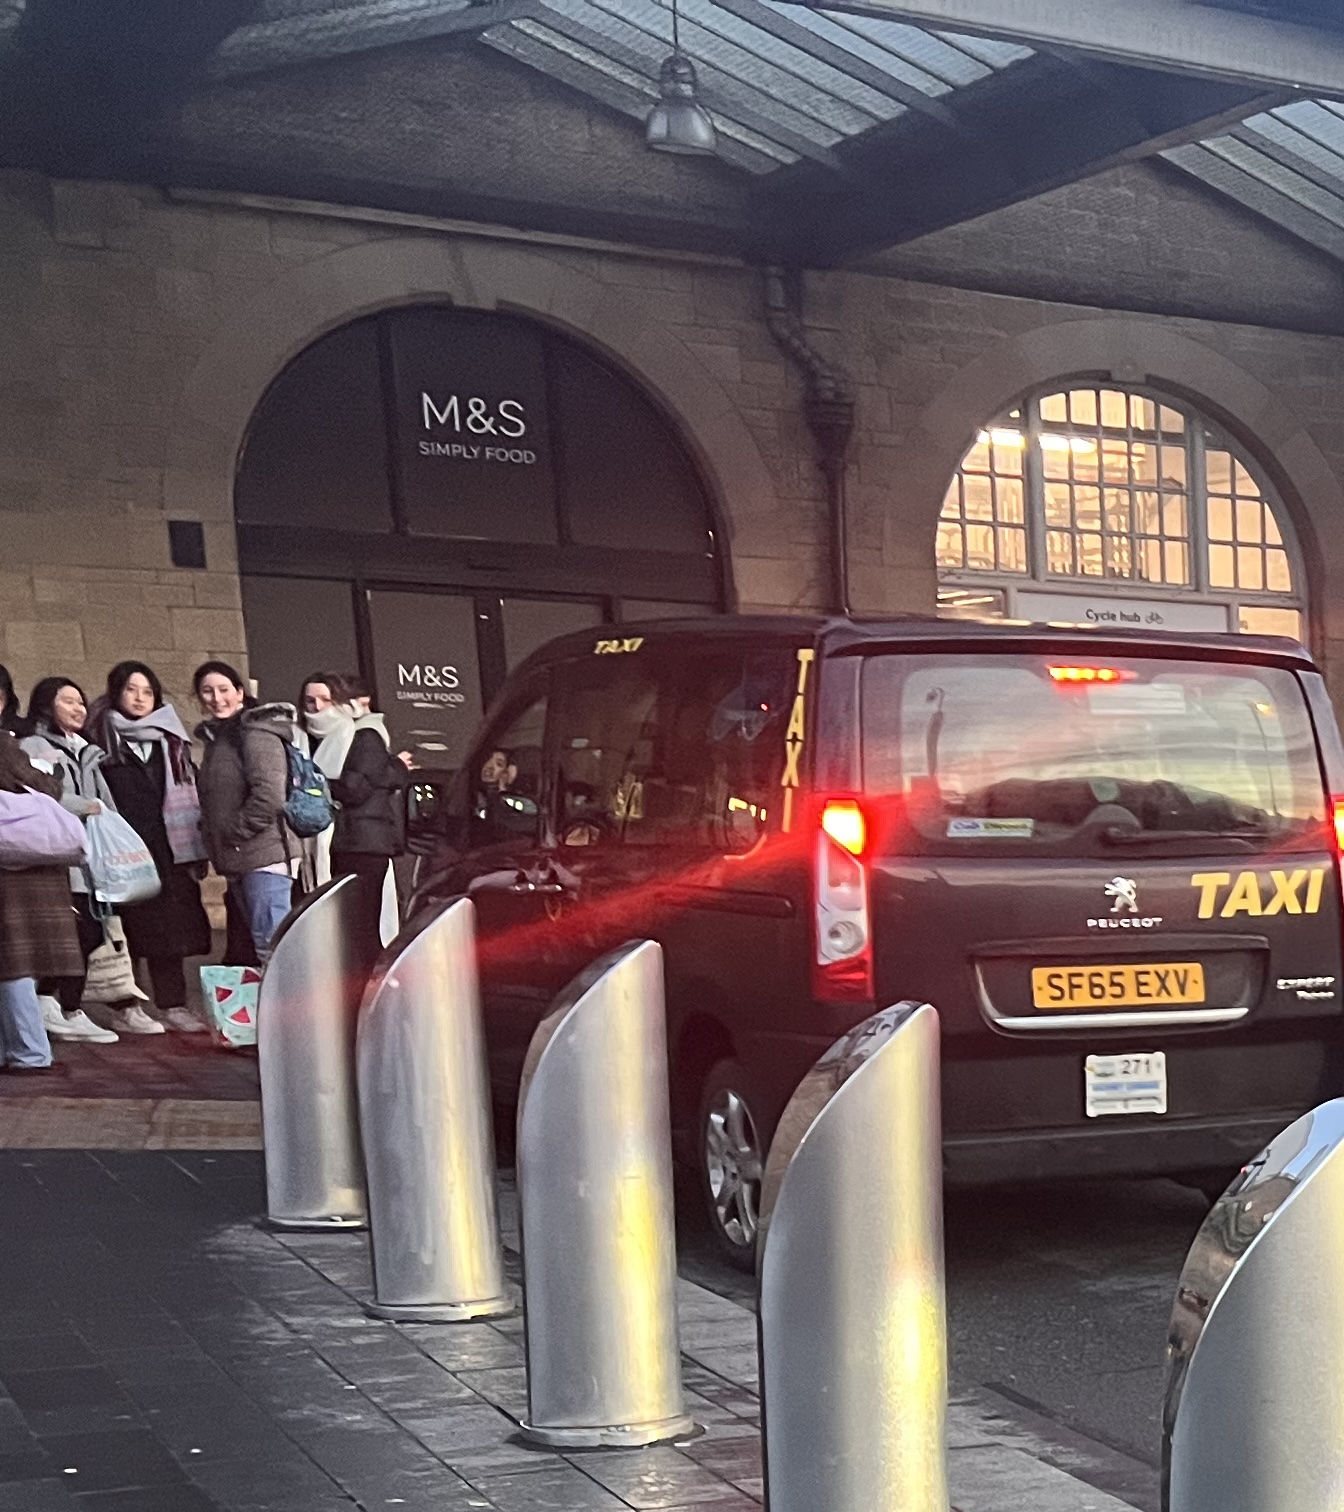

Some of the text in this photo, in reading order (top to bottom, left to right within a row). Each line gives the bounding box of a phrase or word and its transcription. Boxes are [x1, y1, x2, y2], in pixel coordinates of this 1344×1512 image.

[422, 391, 526, 437] M&S
[419, 441, 537, 464] SIMPLY FOOD
[1085, 608, 1141, 623] Cycle hub
[594, 637, 644, 654] TAXI
[398, 663, 460, 689] M&S
[396, 690, 465, 702] SIMPLY FOOD
[781, 648, 815, 833] TAXI
[1191, 868, 1325, 918] TAXI
[1087, 917, 1163, 928] PEUGEOT
[1047, 969, 1188, 1001] SF65 EXV
[1122, 1059, 1150, 1075] 271
